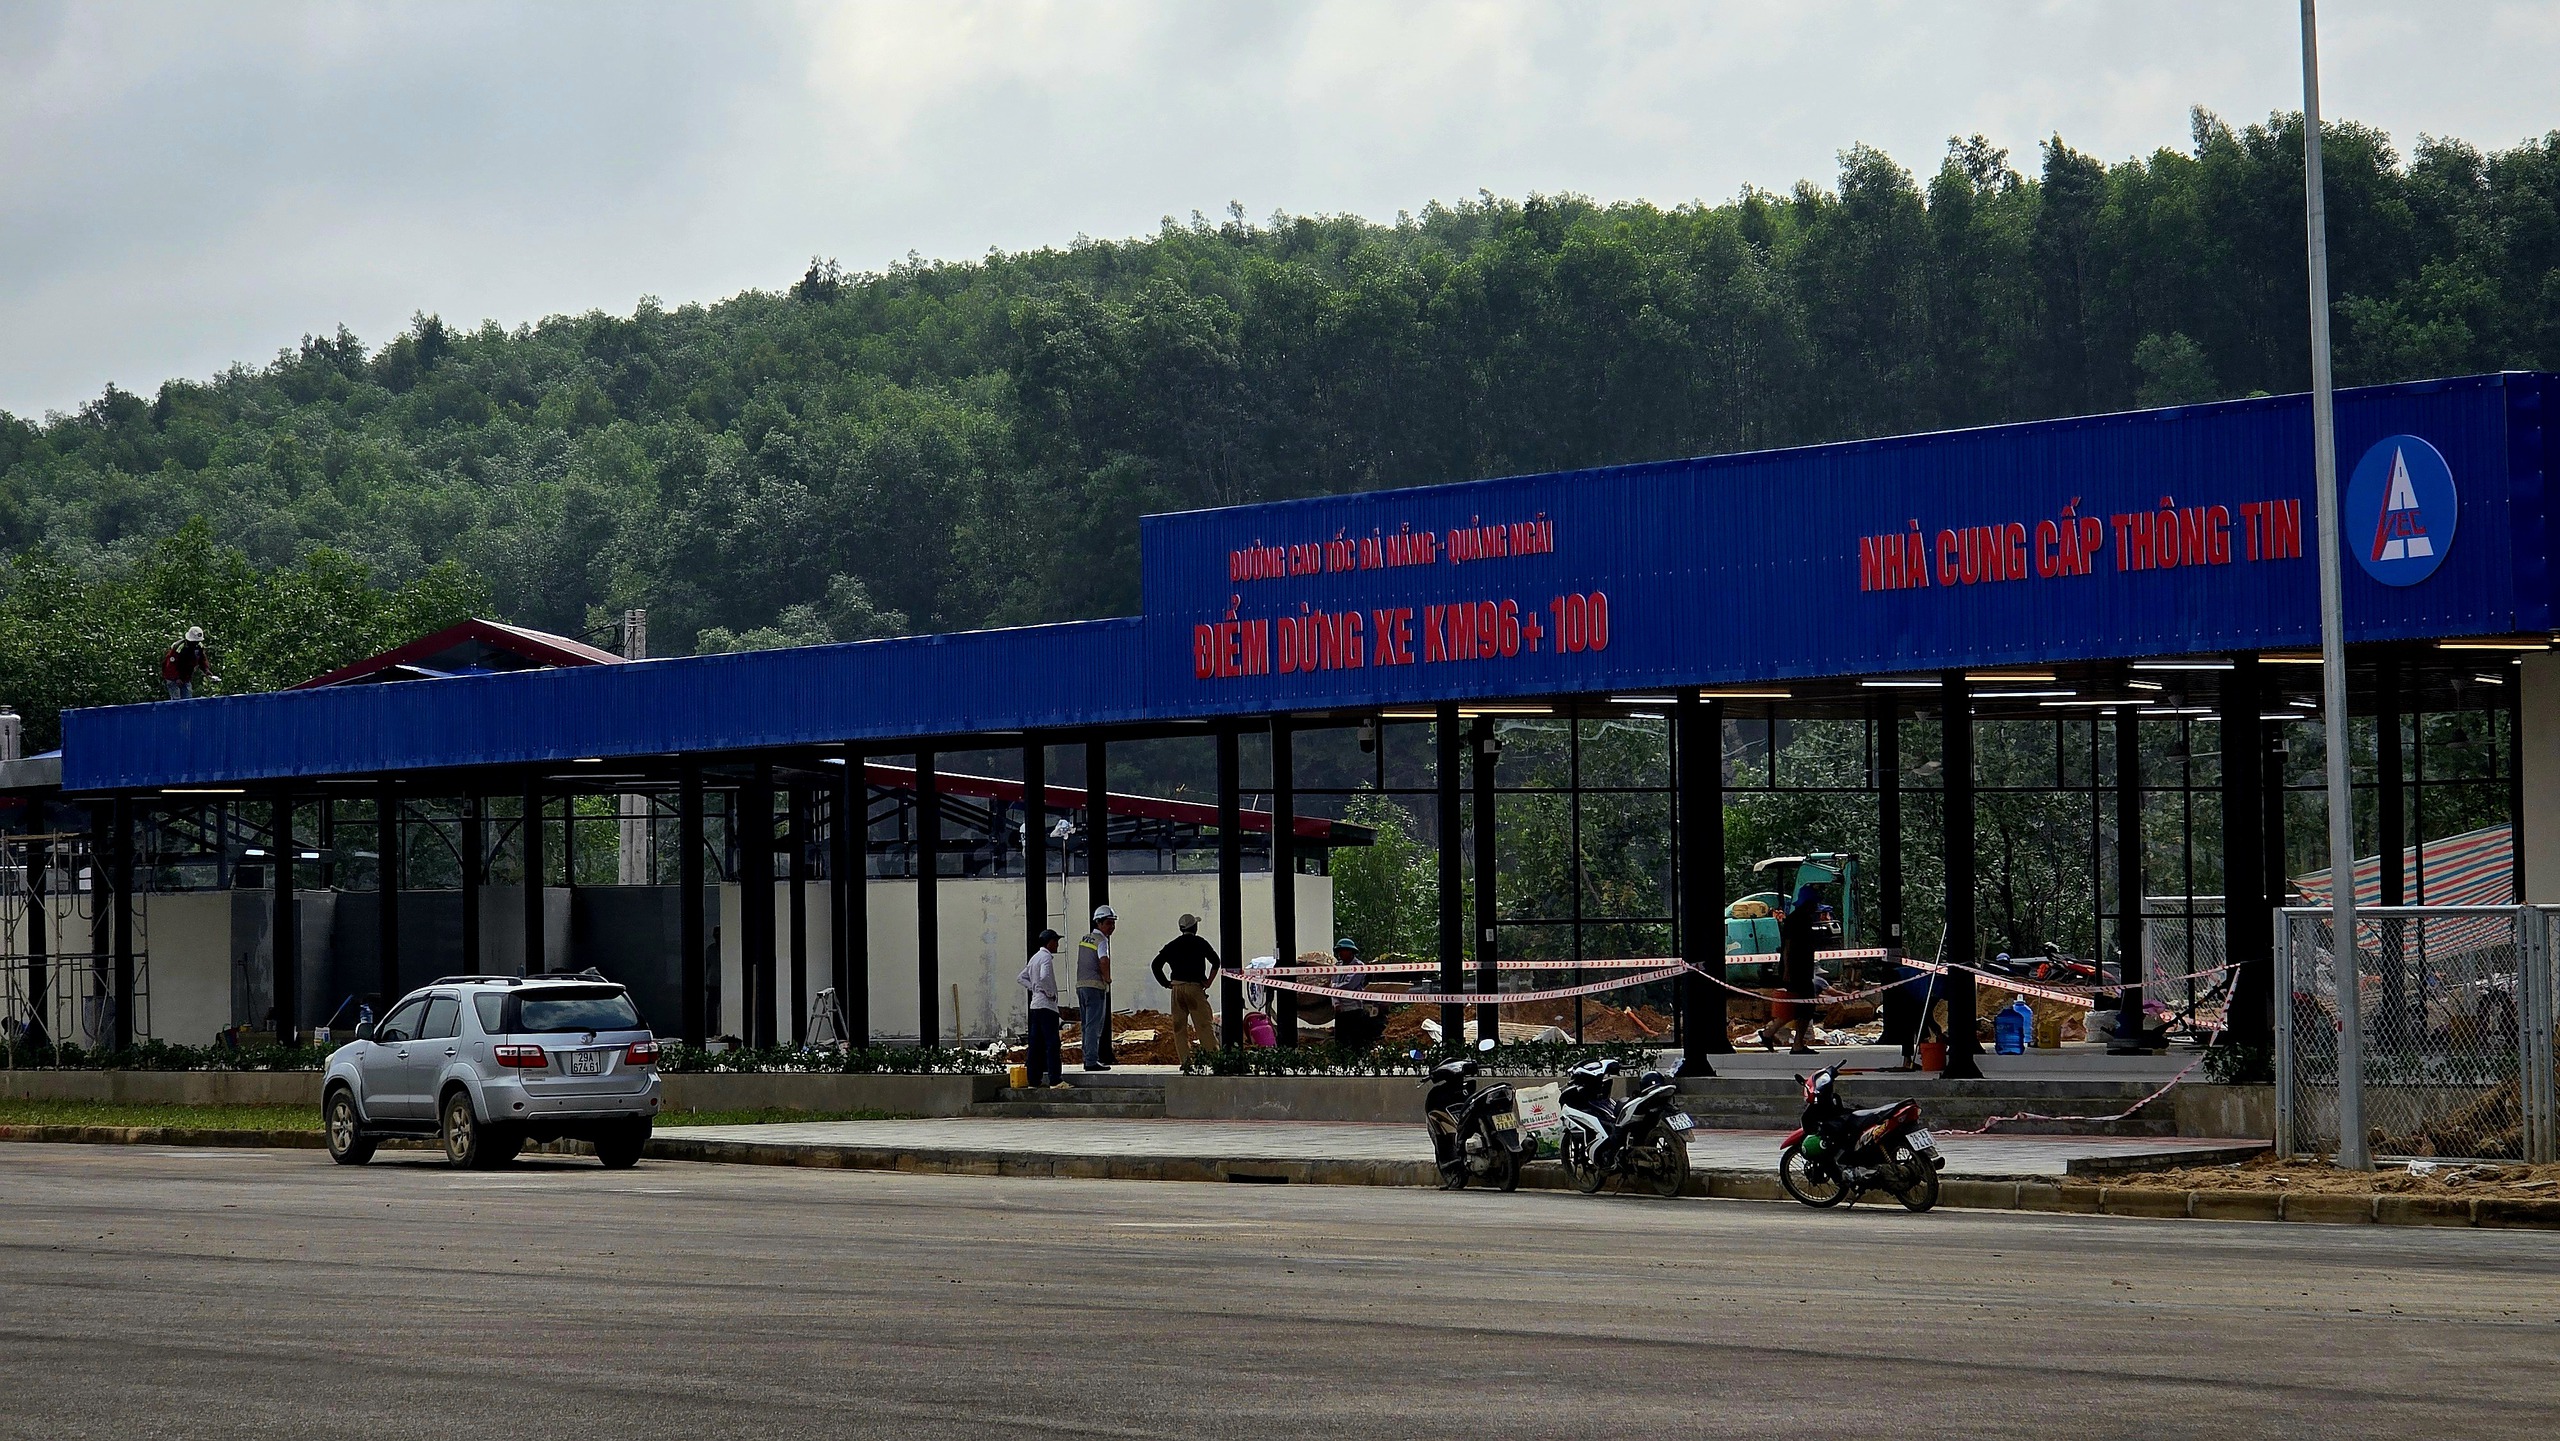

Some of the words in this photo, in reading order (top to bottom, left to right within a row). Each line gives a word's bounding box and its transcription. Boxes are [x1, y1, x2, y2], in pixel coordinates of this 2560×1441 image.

[1230, 537, 1285, 582] ĐƯỜNG
[1288, 542, 1321, 576] CAO
[1324, 526, 1355, 572] TỐC
[1359, 527, 1384, 570] ĐÀ
[1448, 514, 1507, 565] QUẢNG
[1860, 519, 1929, 591] NHÀ
[1937, 522, 2027, 586] CUNG
[2036, 497, 2102, 577] CẤP
[2112, 496, 2231, 572] THÔNG
[2240, 499, 2302, 561] TIN
[1194, 594, 1269, 679] ĐIỂM
[1278, 601, 1364, 674] DỪNG
[1373, 607, 1415, 666] XE
[578, 1052, 594, 1062] 29A
